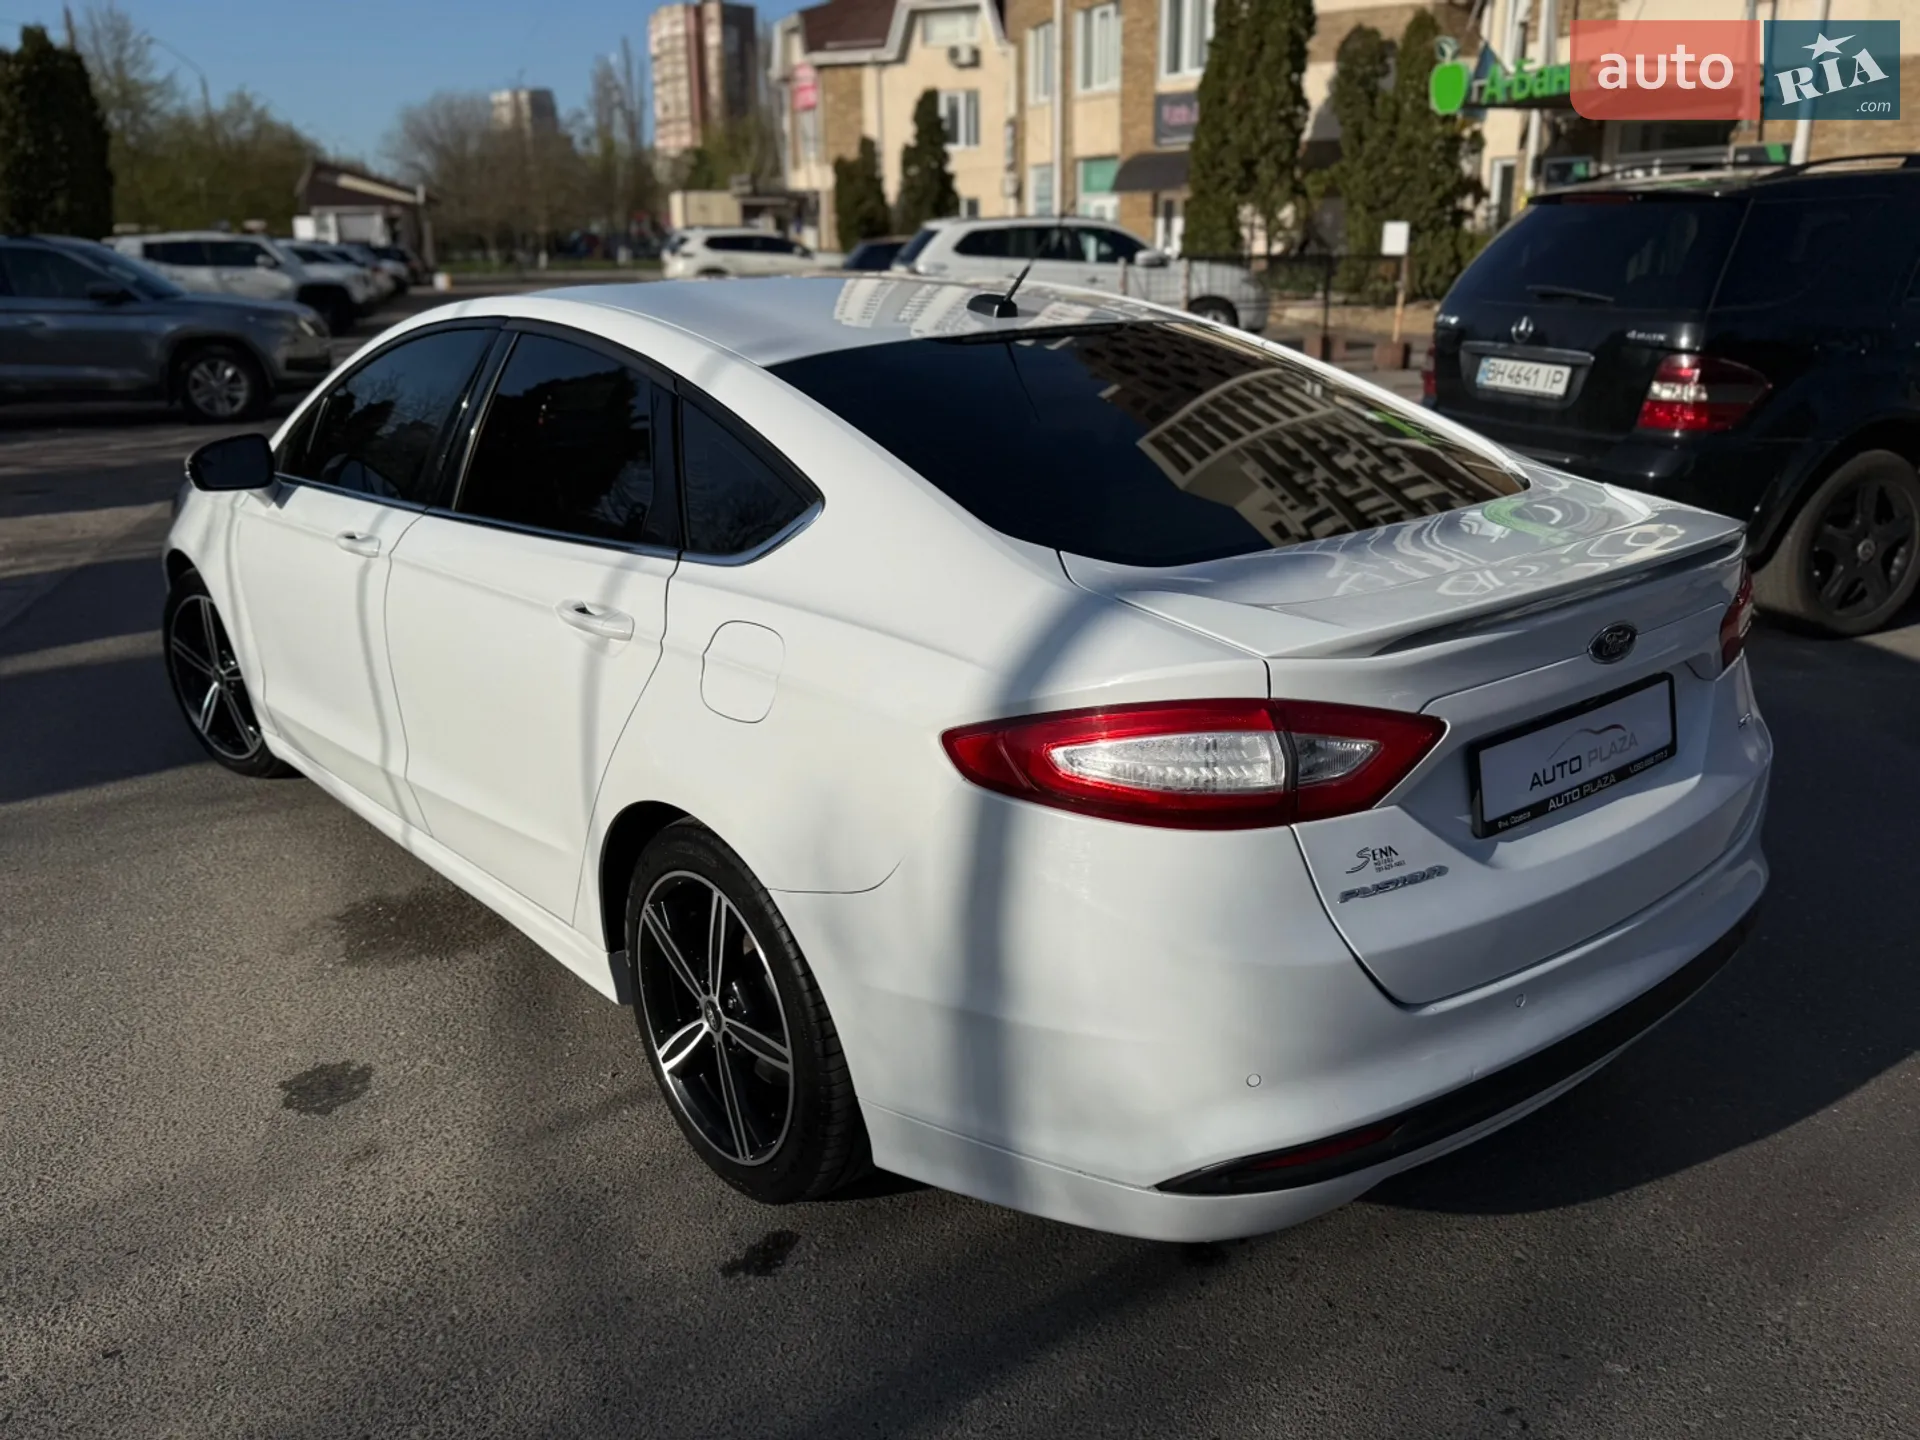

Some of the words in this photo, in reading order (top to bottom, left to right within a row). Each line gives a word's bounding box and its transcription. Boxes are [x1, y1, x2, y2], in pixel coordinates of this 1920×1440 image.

[1529, 755, 1583, 791] AUTO
[1587, 732, 1638, 768] PLAZA
[1548, 787, 1580, 811] AUTO
[1582, 774, 1616, 797] PLAZA
[1345, 845, 1400, 874] SENA
